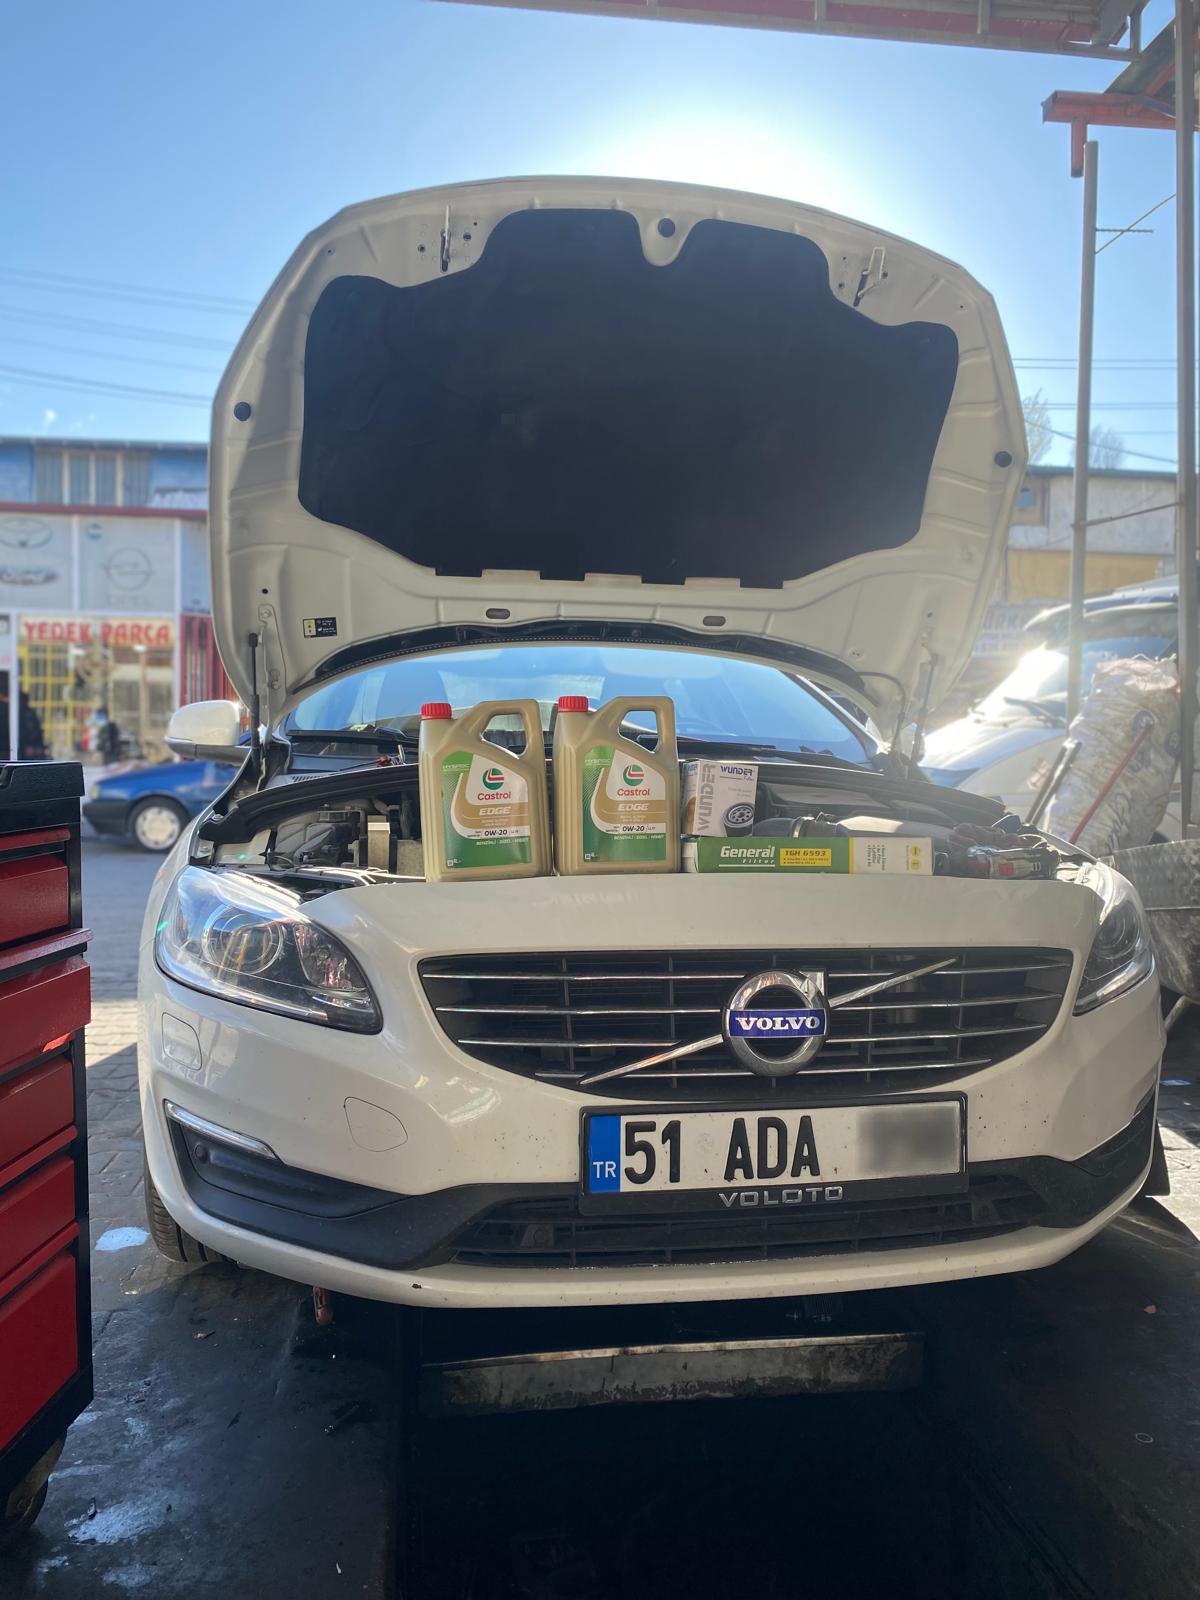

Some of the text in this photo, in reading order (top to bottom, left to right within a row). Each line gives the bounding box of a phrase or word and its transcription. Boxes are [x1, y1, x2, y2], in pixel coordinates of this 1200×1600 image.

[24, 621, 93, 643] YEDEK
[720, 765, 753, 776] WUNDER
[477, 791, 512, 801] Castrol
[617, 788, 650, 797] Castrol
[697, 763, 716, 831] WUNDER
[479, 807, 512, 816] EDGE
[617, 803, 648, 811] EDGE
[484, 828, 508, 837] 0W-20
[720, 845, 775, 858] General
[736, 1015, 820, 1031] VOLVO
[593, 1115, 821, 1184] TR 51 ADA
[718, 1186, 843, 1208] VOLOTO
